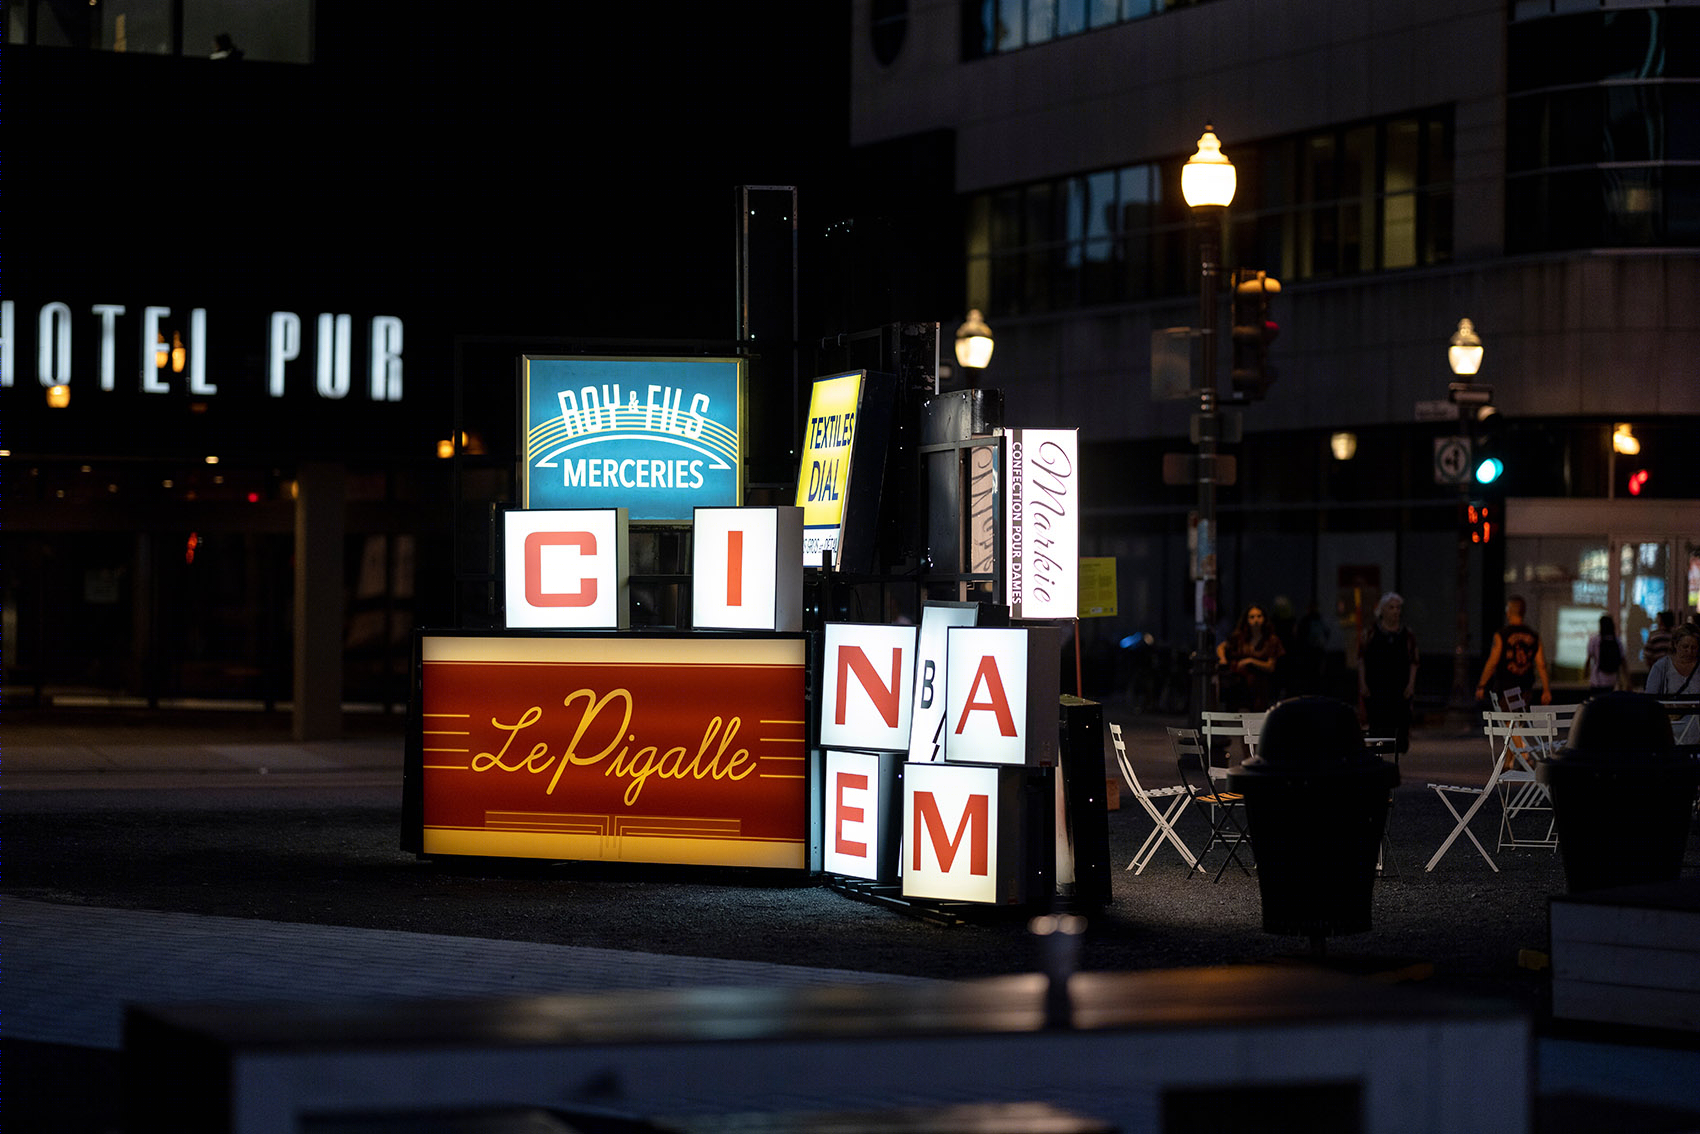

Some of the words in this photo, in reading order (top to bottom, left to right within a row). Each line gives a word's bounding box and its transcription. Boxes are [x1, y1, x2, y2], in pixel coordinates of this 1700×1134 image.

[269, 311, 404, 401] PUR
[557, 384, 621, 437] ROY
[628, 390, 640, 413] &
[645, 384, 710, 439] FILS
[809, 412, 855, 450] TEXTILES
[563, 458, 704, 489] MERCERIES
[808, 458, 840, 502] DIAL
[1012, 441, 1022, 521] CONFECTION
[1012, 525, 1022, 558] POUR
[1029, 441, 1073, 603] Markie
[524, 531, 598, 608] C
[726, 530, 744, 607] I
[1012, 562, 1022, 604] DAMES
[835, 645, 903, 729] N
[954, 655, 1018, 737] A
[471, 706, 556, 774] Le
[546, 688, 757, 807] Pigalle
[835, 771, 868, 858] E
[912, 790, 989, 877] M
